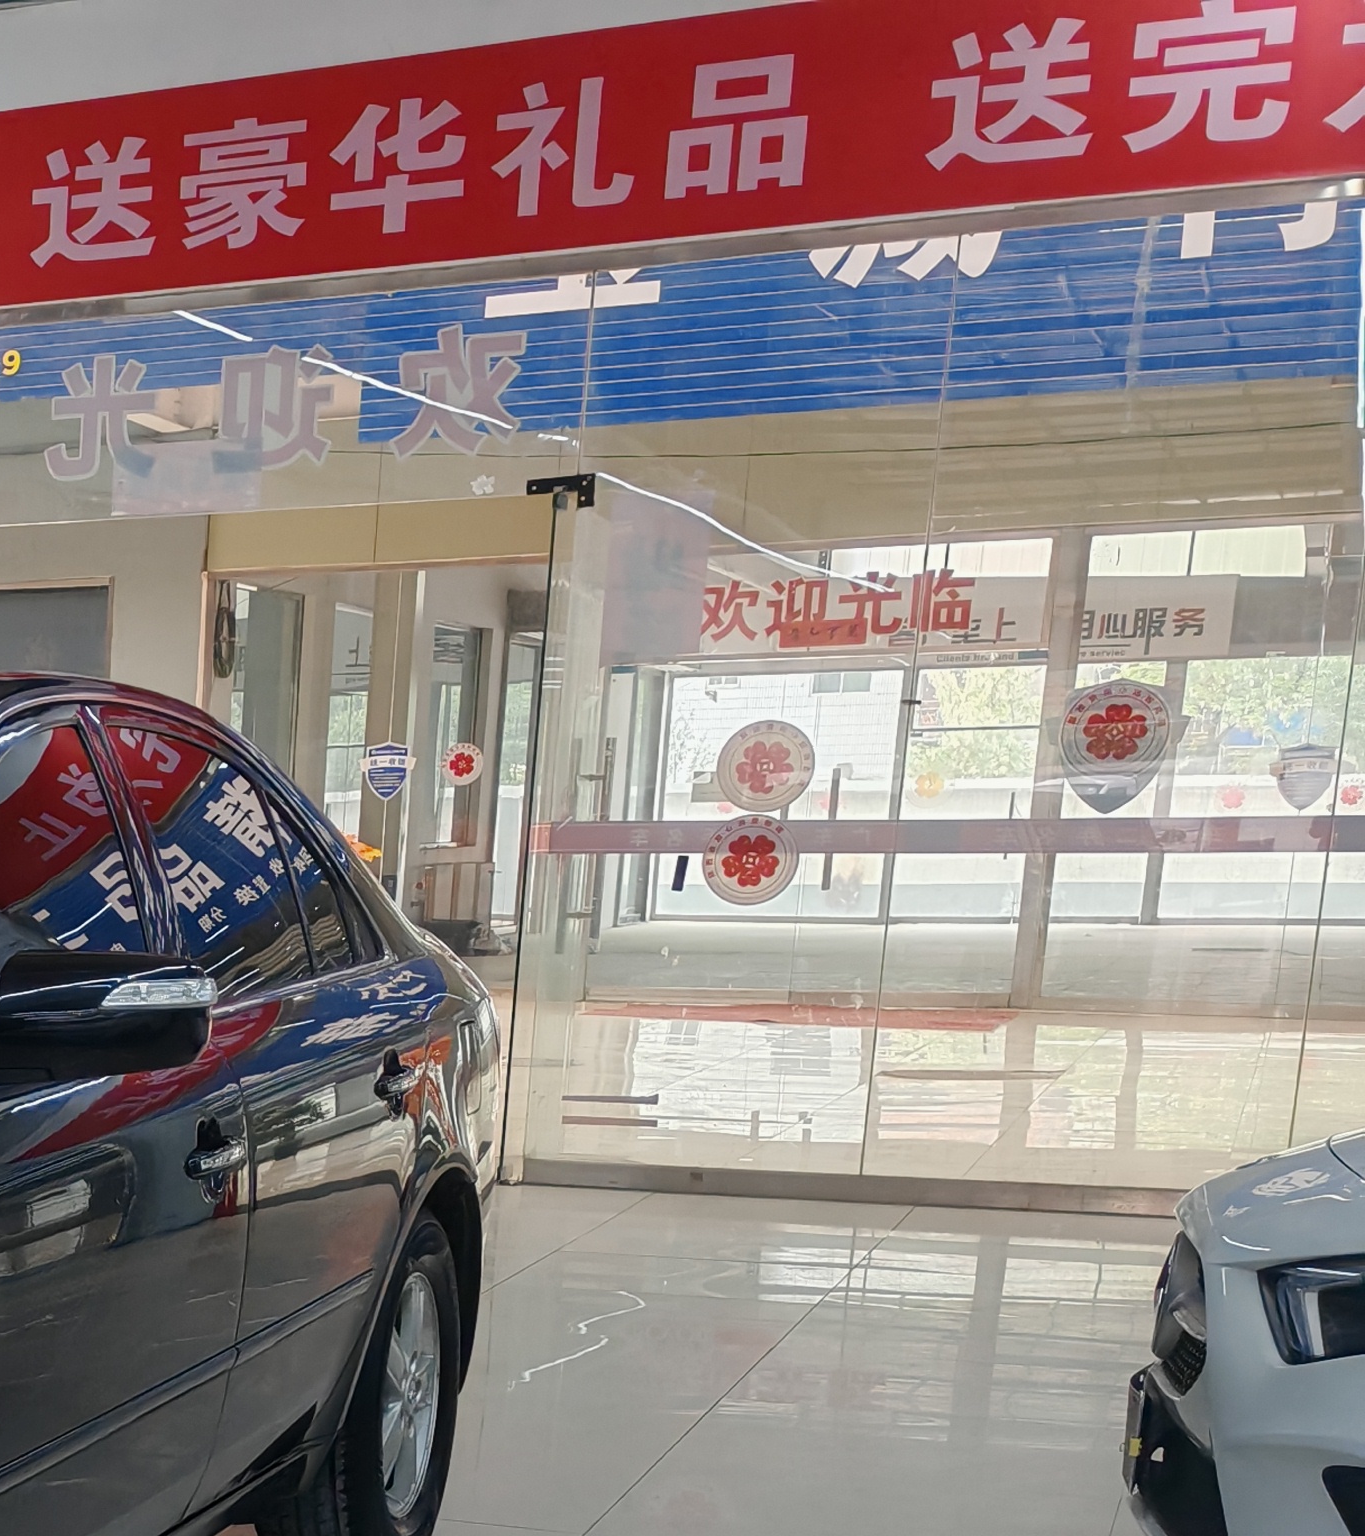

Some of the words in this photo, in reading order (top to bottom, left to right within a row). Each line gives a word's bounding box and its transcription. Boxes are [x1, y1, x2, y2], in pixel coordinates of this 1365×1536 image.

[31, 53, 809, 267] 送豪华礼品
[700, 568, 976, 641] 欢迎光临
